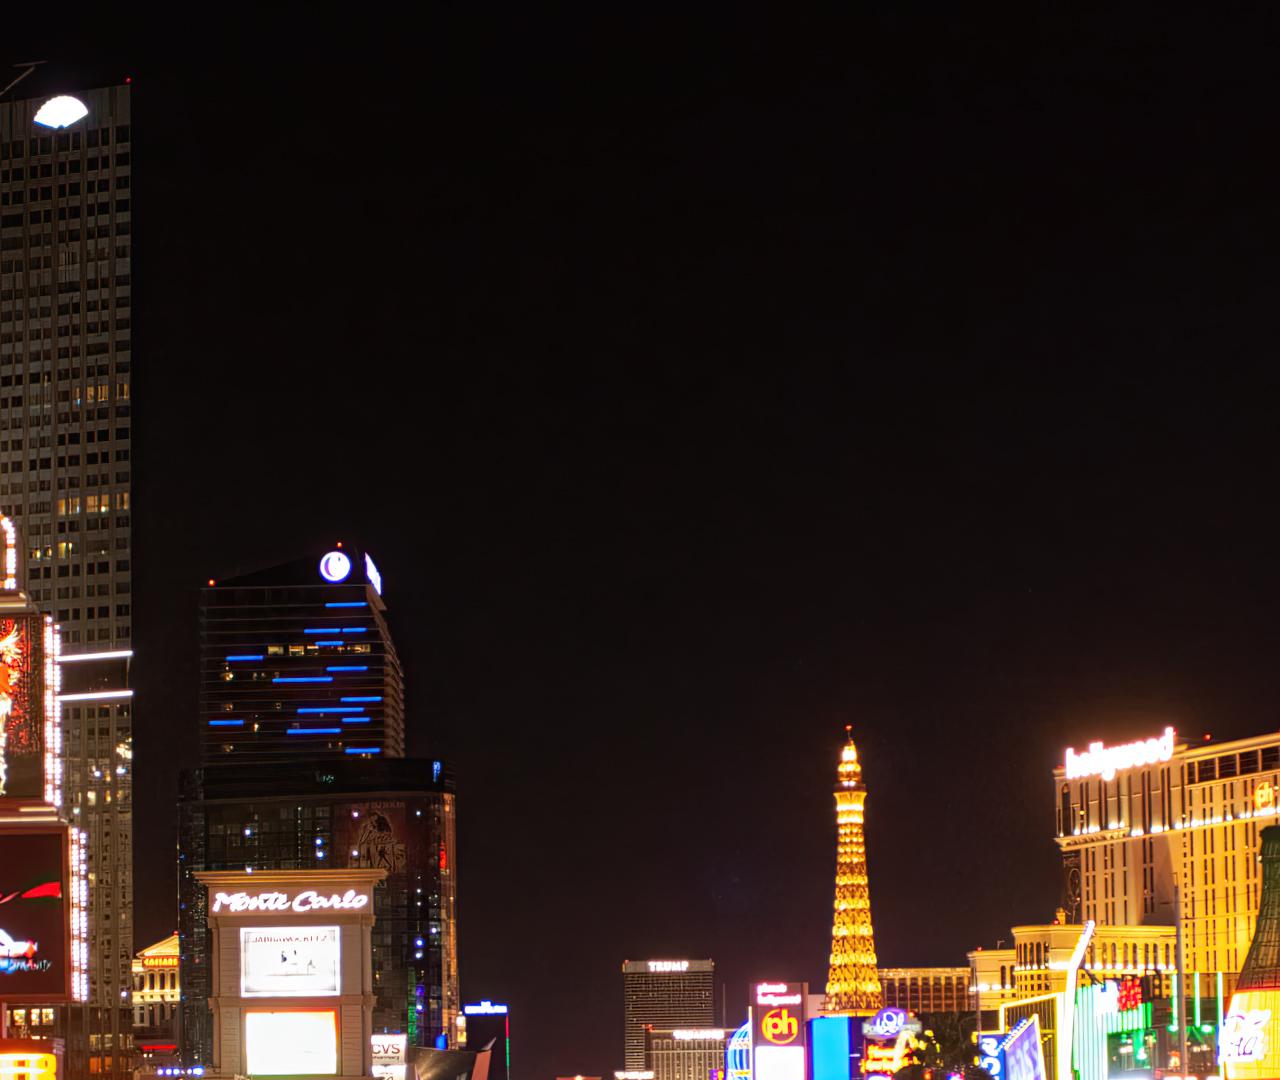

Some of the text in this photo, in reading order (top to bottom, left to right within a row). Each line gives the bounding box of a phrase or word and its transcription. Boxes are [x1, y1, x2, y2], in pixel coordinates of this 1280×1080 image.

[212, 889, 370, 913] Monte Carlo
[648, 961, 689, 972] TRUMP
[767, 1009, 799, 1043] ph
[371, 1043, 400, 1055] CVS
